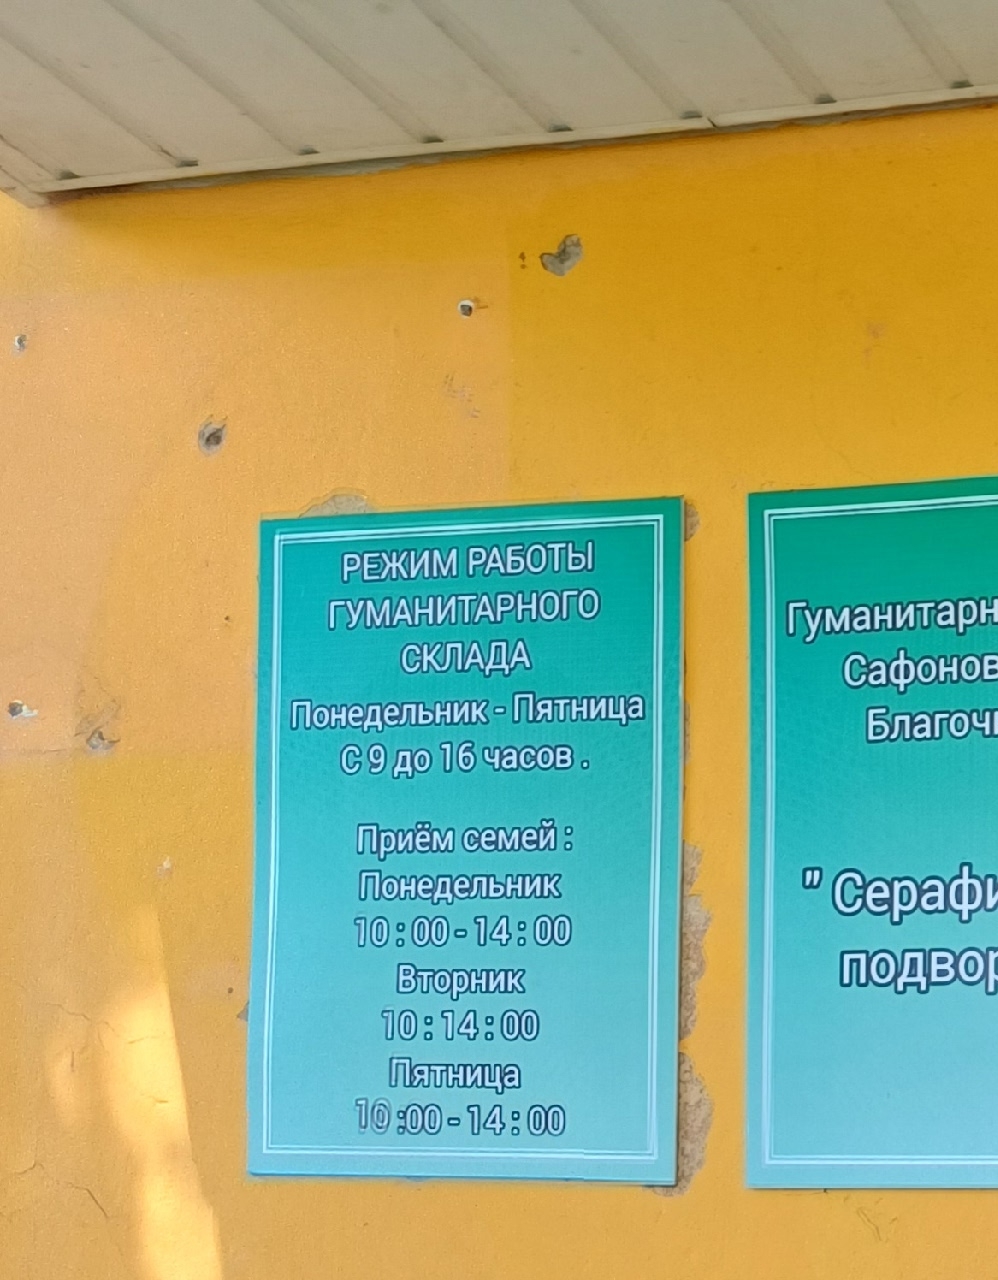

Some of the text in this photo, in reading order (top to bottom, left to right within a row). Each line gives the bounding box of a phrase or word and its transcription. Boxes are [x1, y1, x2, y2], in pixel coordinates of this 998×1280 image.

[342, 541, 594, 583] РЕЖИМ РАБОТЫ
[328, 589, 600, 629] ГУМАНИТАРНОГО
[400, 639, 531, 677] СКЛАДА
[290, 699, 488, 732] Понедельник
[512, 692, 645, 726] Пятница
[340, 745, 361, 774] С
[368, 744, 386, 773] 9
[393, 749, 430, 779] до
[440, 742, 474, 771] 16
[357, 822, 454, 860] Приём
[359, 871, 561, 905] Понедельник
[397, 963, 525, 1000] Вторник
[389, 1057, 521, 1094] Пятница
